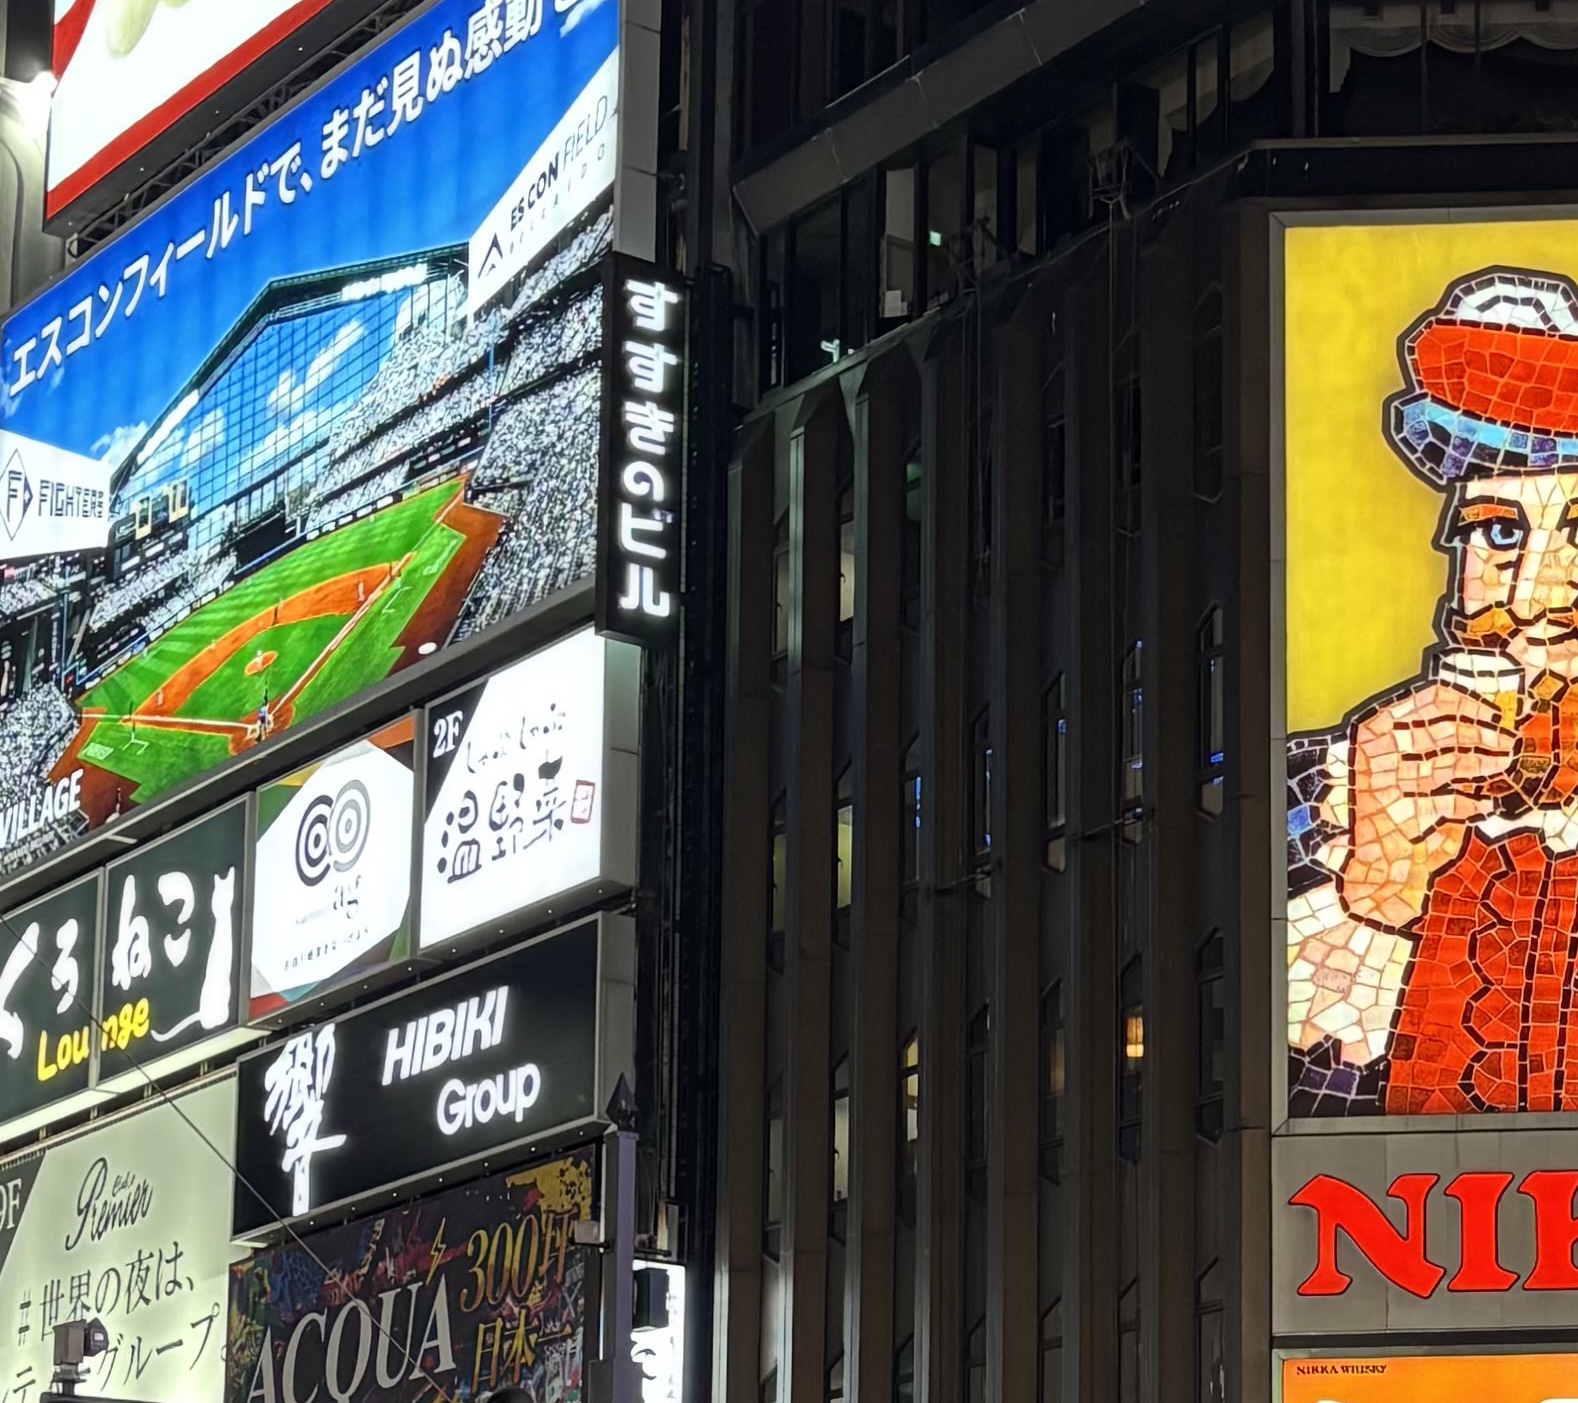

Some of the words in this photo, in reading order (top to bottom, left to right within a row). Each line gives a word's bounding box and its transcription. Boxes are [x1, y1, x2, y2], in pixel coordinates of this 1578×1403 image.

[9, 0, 581, 398] エスコンフィールドで、まだ見ぬ感動
[38, 479, 104, 519] FIGHTERS
[433, 710, 464, 759] 2F
[37, 997, 150, 1082] Lounge
[381, 985, 509, 1087] HIBIKI
[436, 1062, 542, 1136] Group
[65, 1156, 154, 1252] Premier
